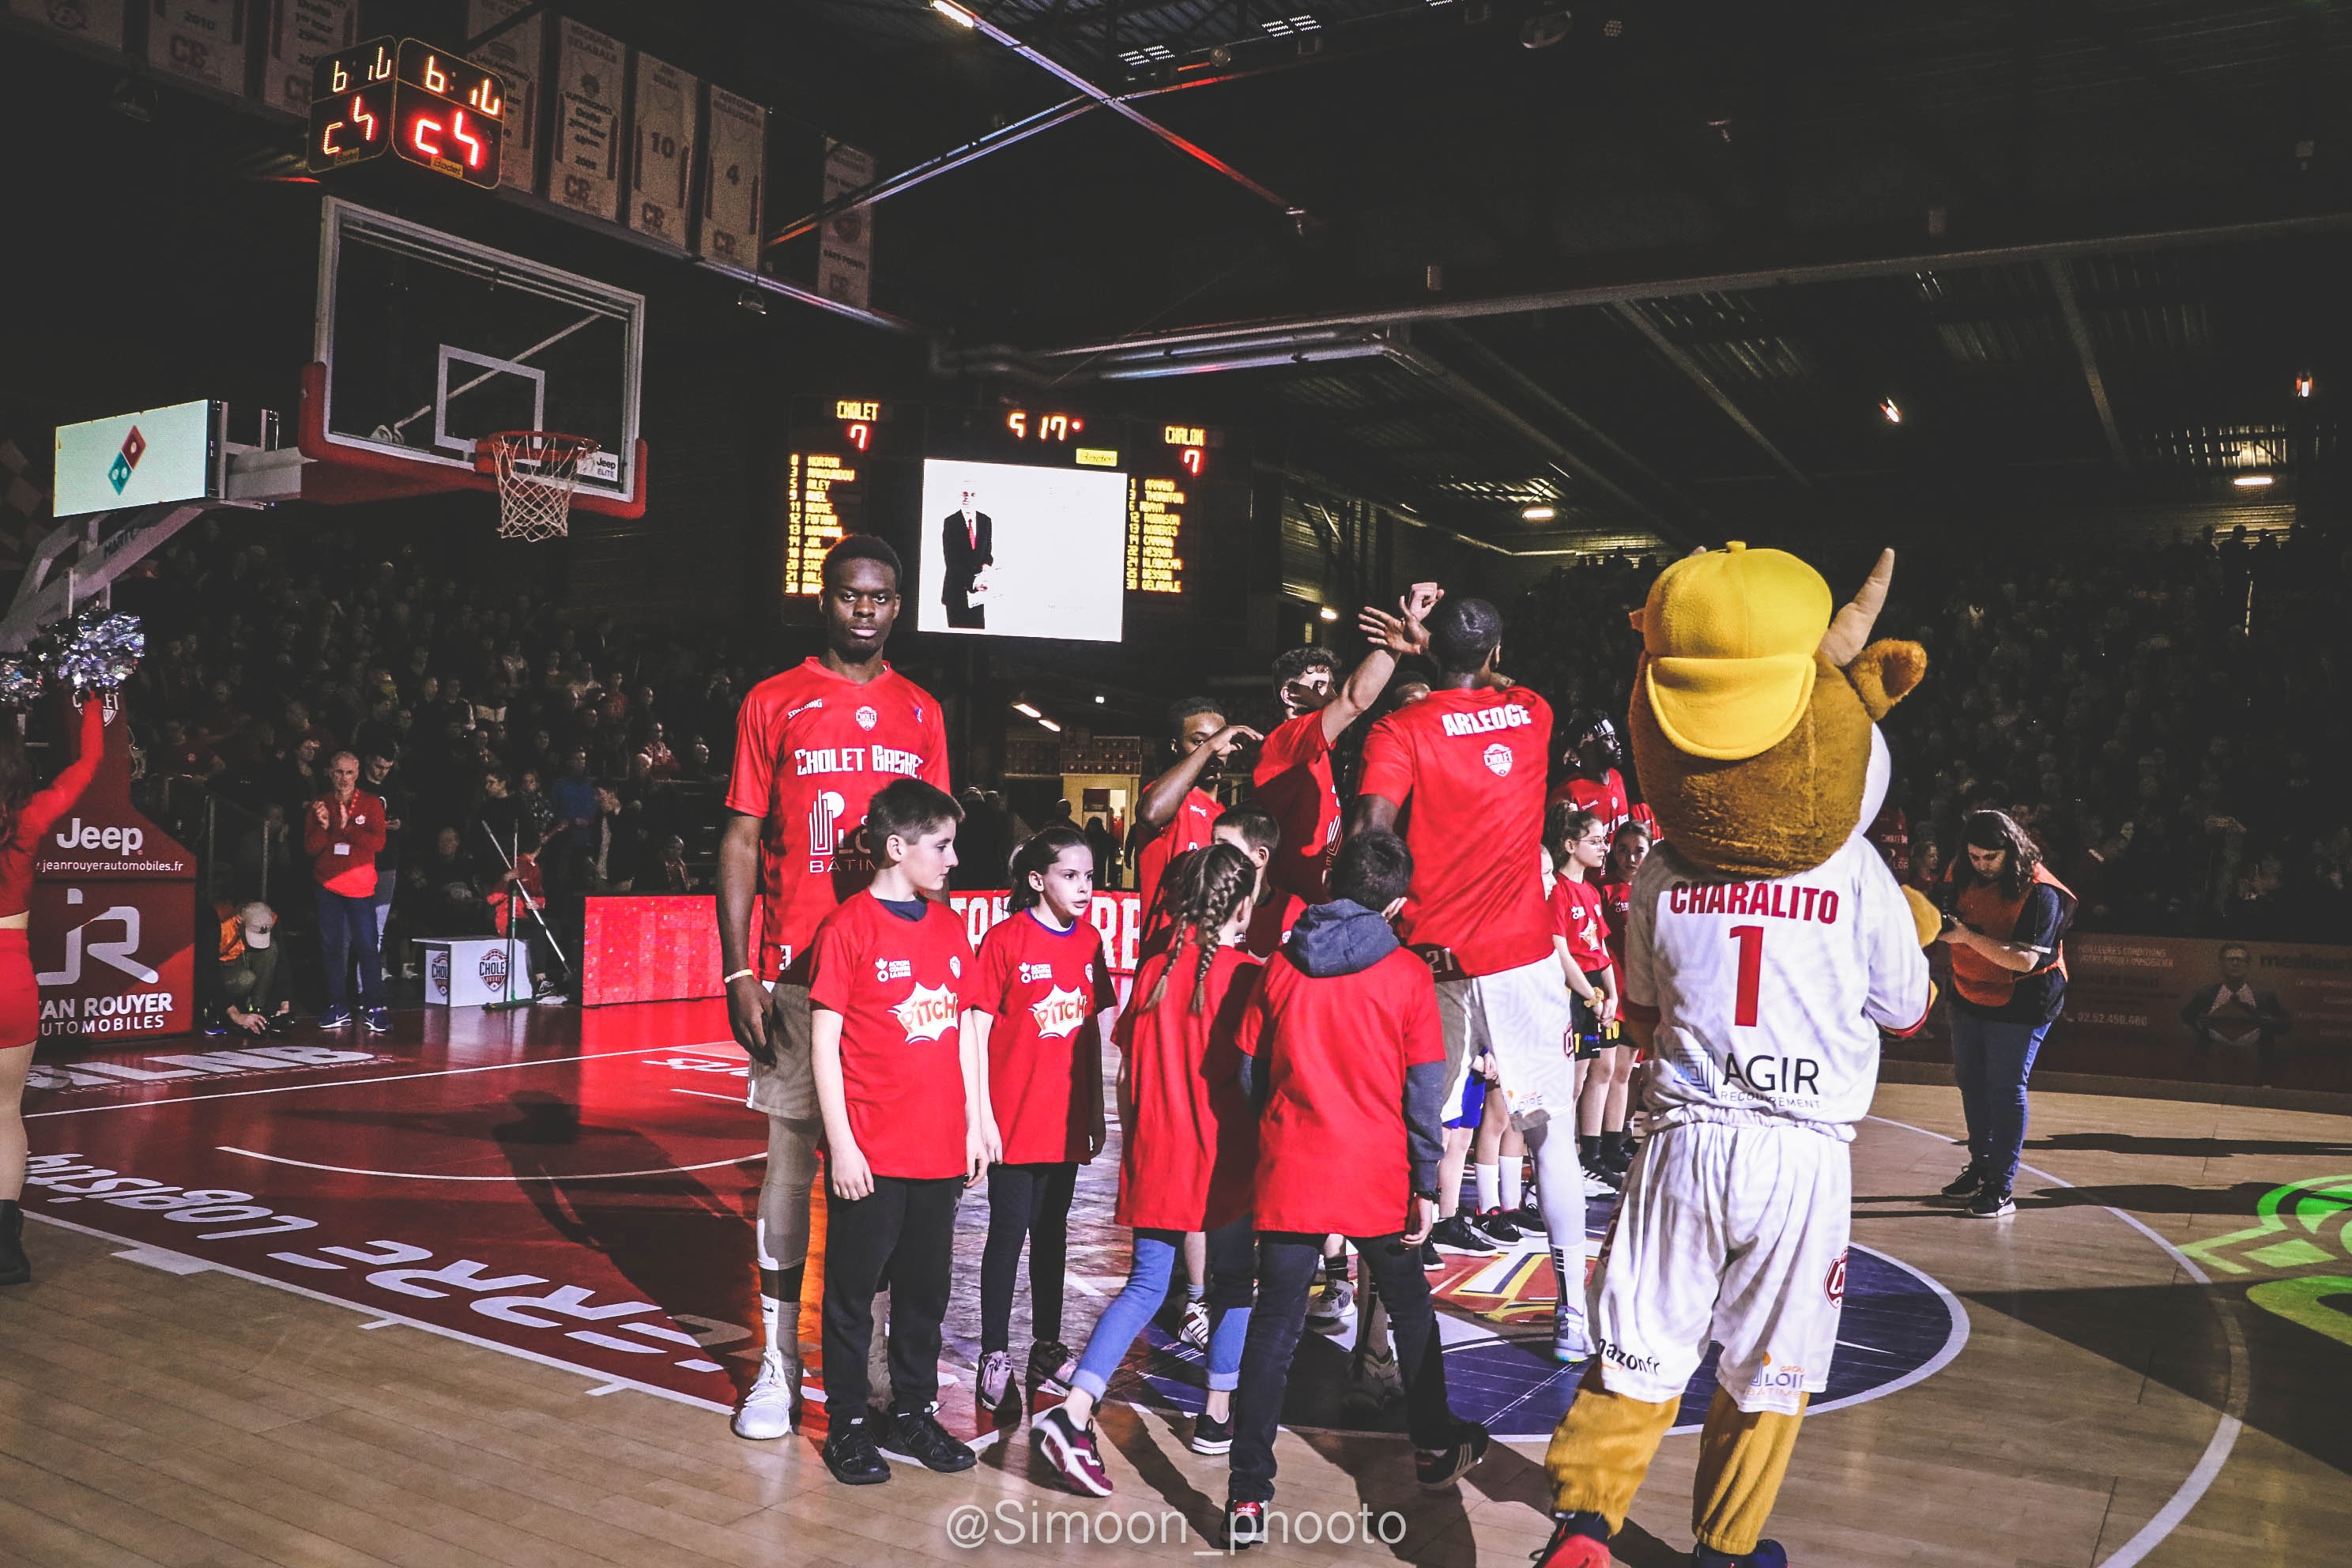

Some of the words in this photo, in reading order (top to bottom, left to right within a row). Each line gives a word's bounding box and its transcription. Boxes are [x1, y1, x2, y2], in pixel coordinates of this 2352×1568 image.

[651, 132, 675, 159] 10
[434, 158, 462, 175] Bodet
[726, 164, 740, 187] 4
[836, 401, 879, 421] CHOLET
[1165, 426, 1205, 447] CHALON
[597, 456, 616, 469] Jeep
[597, 468, 616, 478] ELITE
[790, 466, 798, 477] 3
[790, 478, 797, 488] 5
[1130, 478, 1136, 489] 1
[1129, 489, 1136, 500] 3
[790, 501, 801, 512] 11
[790, 513, 801, 523] 12
[1129, 512, 1140, 523] 12
[789, 524, 801, 535] 13
[1129, 523, 1140, 534] 13
[788, 536, 801, 547] 14
[788, 698, 823, 720] SPALDING
[855, 712, 877, 722] CHOLET
[1441, 703, 1532, 737] ARLEDGE
[794, 748, 866, 776] CHOLET
[1483, 750, 1513, 767] CHOLET
[56, 817, 143, 856] Jeep
[37, 860, 184, 873] jeanrouyerautomobiles.fr
[1670, 881, 1839, 925] CHARALITO
[1427, 948, 1453, 974] 21
[432, 963, 448, 978] CHOL
[1729, 925, 1764, 1027] 1
[40, 999, 75, 1020] AN
[84, 993, 173, 1018] ROUYER
[41, 1014, 164, 1036] UTOMOBILES
[1722, 1052, 1819, 1095] AGIR
